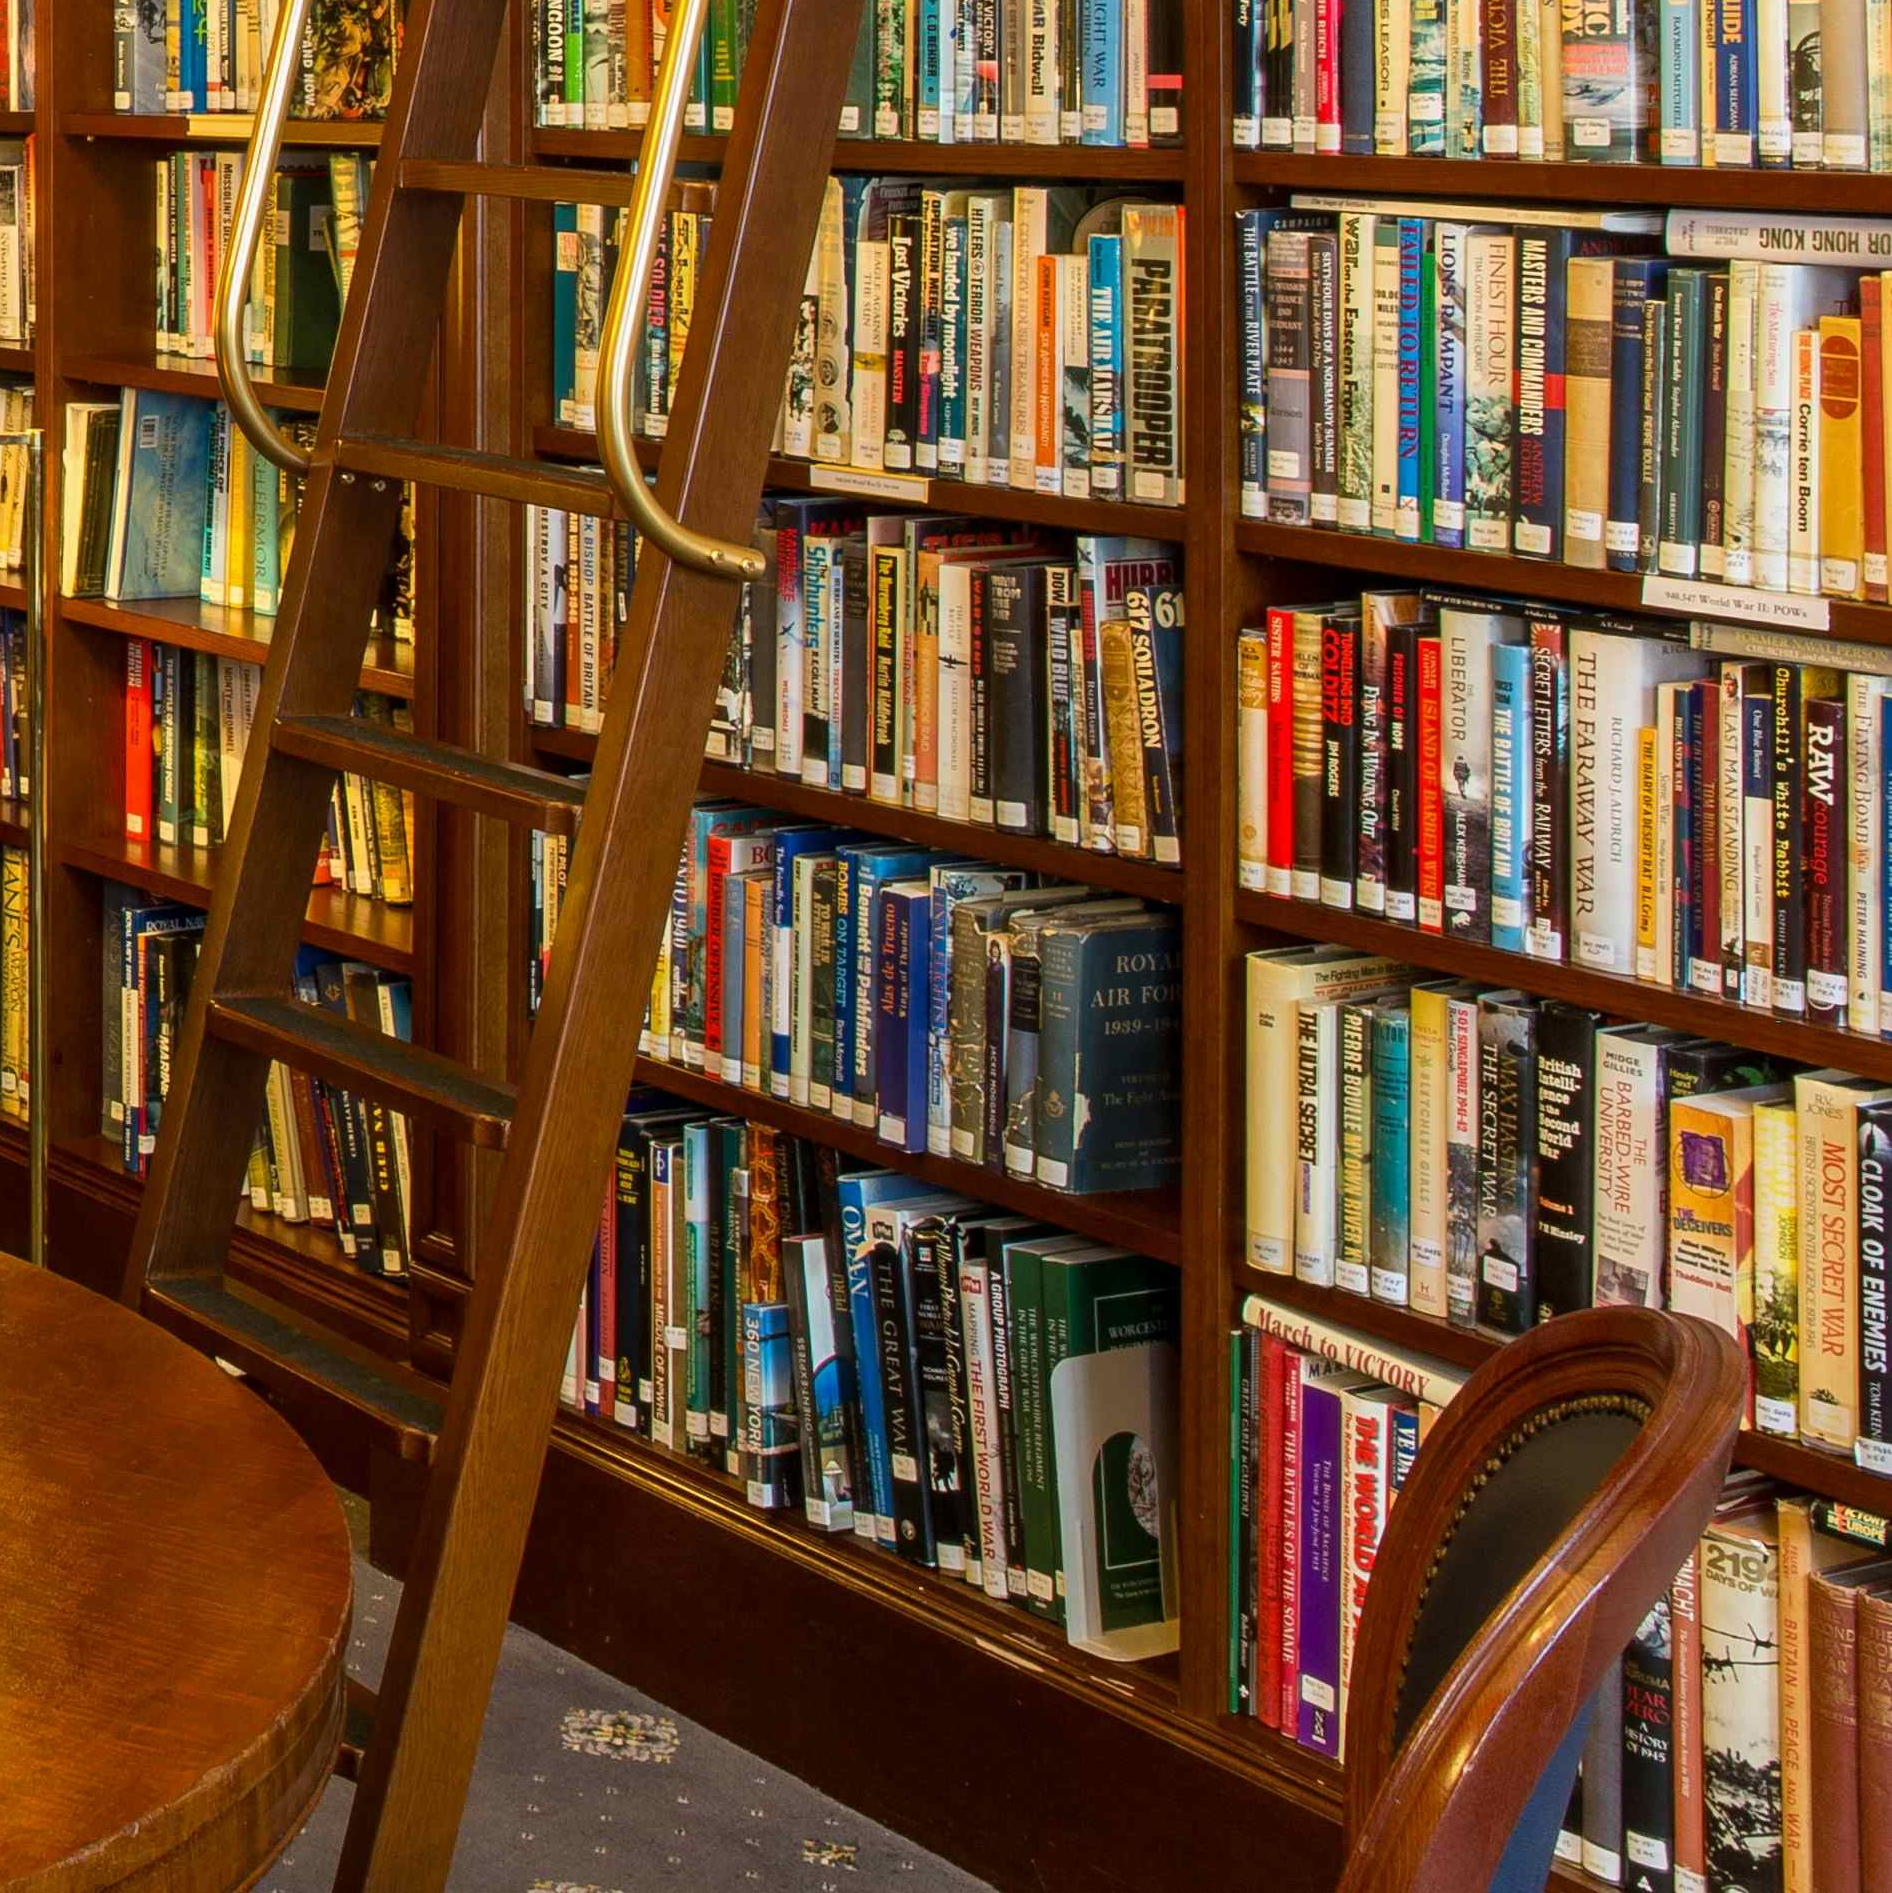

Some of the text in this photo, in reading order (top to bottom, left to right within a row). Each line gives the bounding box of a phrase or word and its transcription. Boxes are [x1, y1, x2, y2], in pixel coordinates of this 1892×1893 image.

[1032, 34, 1044, 95] Bidwell
[893, 237, 911, 337] Lost Victories
[1440, 235, 1456, 412] LIONS RAMPANT
[1490, 243, 1507, 385] FINEST HOUR
[1520, 240, 1546, 436] MASTERS AND COMMANDERS
[893, 350, 904, 404] MANSTEIN
[1797, 404, 1811, 532] Corrie ten Boom
[1127, 592, 1161, 748] 617 SQUADRON
[1698, 596, 1729, 608] World
[1733, 599, 1753, 610] War
[1756, 603, 1770, 613] II:
[1773, 604, 1808, 617] POWs
[1452, 636, 1466, 742] LIBERATOR
[1455, 810, 1467, 887] ALEX KERSHAW
[1494, 707, 1513, 878] THE BATTLE OF BRITAIN
[1576, 652, 1596, 917] THE FARAWAY WAR
[1775, 669, 1793, 897] Churchill's White Rabbit
[1809, 724, 1834, 885] RAW courage
[1482, 1044, 1498, 1217] THE SECRET WAR
[1821, 1140, 1846, 1357] MOST SECRET WAR
[1861, 1158, 1888, 1374] CLOAK OF ENEMIES
[966, 1302, 997, 1559] MAPPING THE FIRST WORLD WAR
[1258, 1308, 1430, 1397] March to VICTORY
